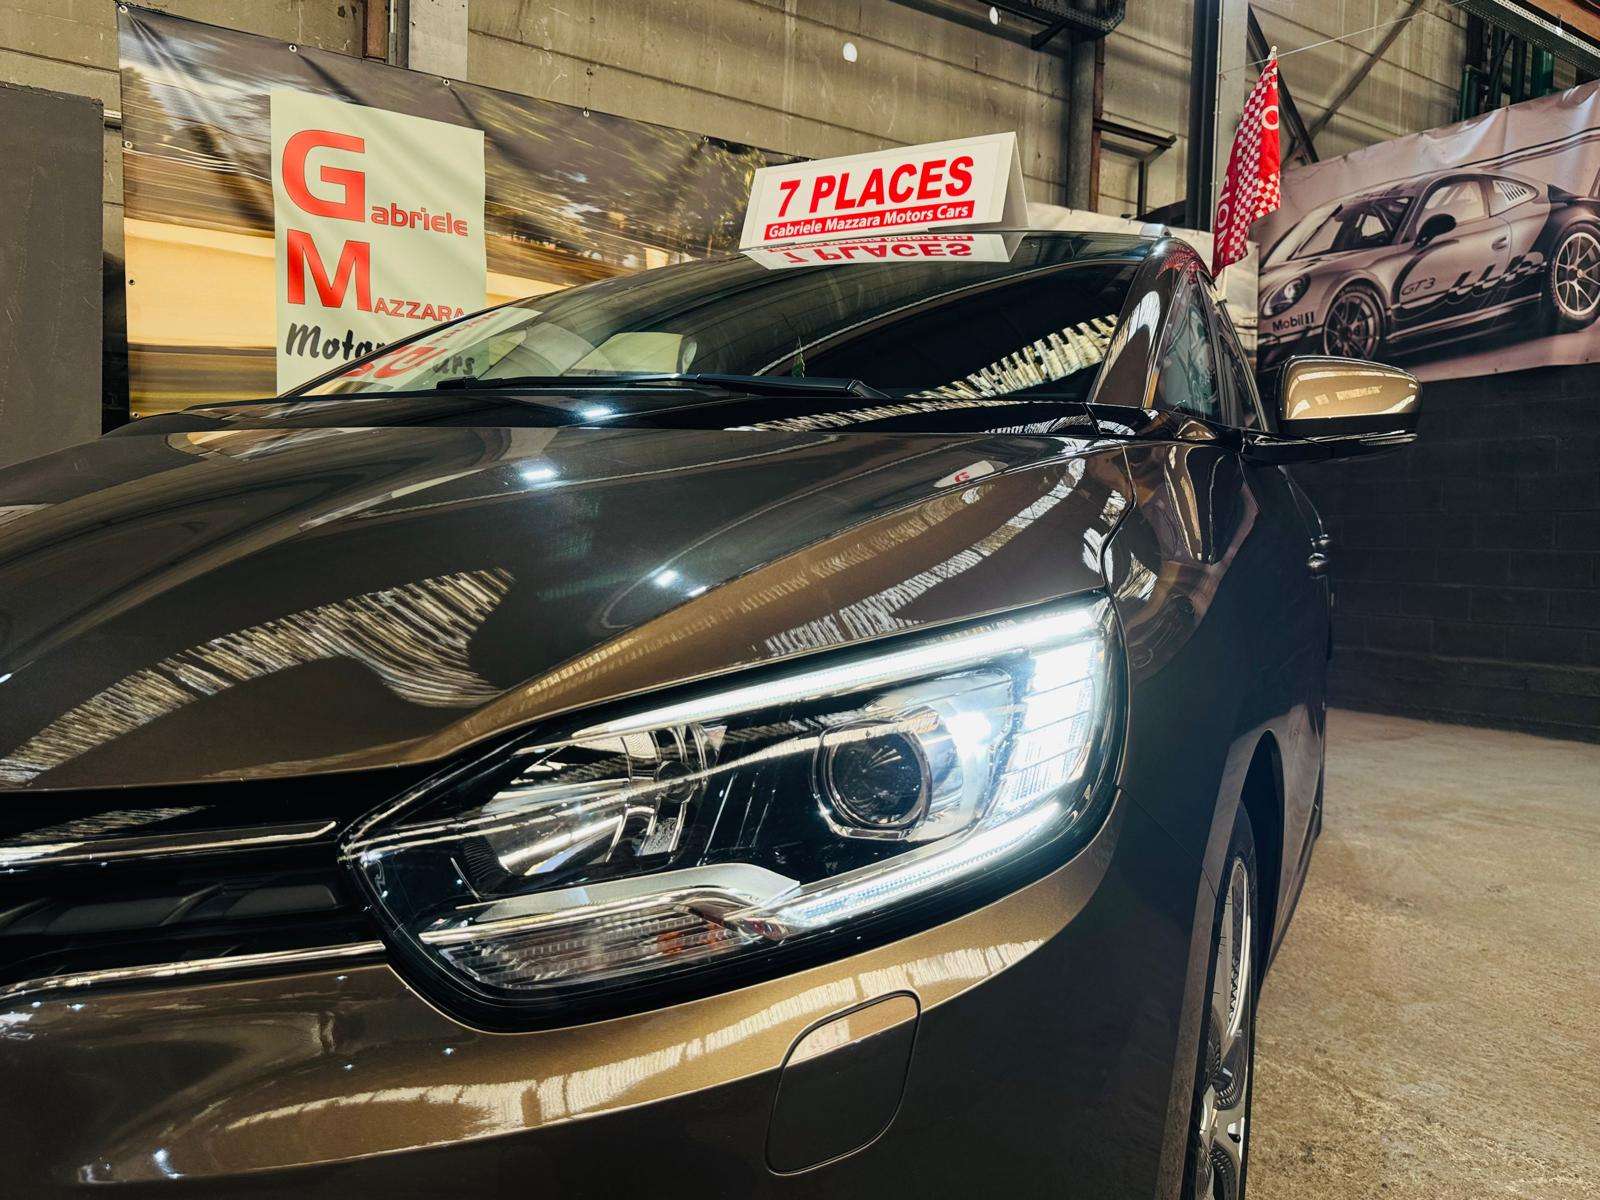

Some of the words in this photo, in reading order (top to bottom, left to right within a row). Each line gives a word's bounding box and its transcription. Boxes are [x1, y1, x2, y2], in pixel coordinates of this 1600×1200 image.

[281, 129, 469, 237] Gabriele
[777, 180, 801, 218] 7
[808, 155, 974, 214] PLACES
[768, 220, 822, 239] Gabriele
[825, 216, 880, 232] Mazzara
[883, 209, 933, 226] Motors
[937, 205, 970, 219] Cars
